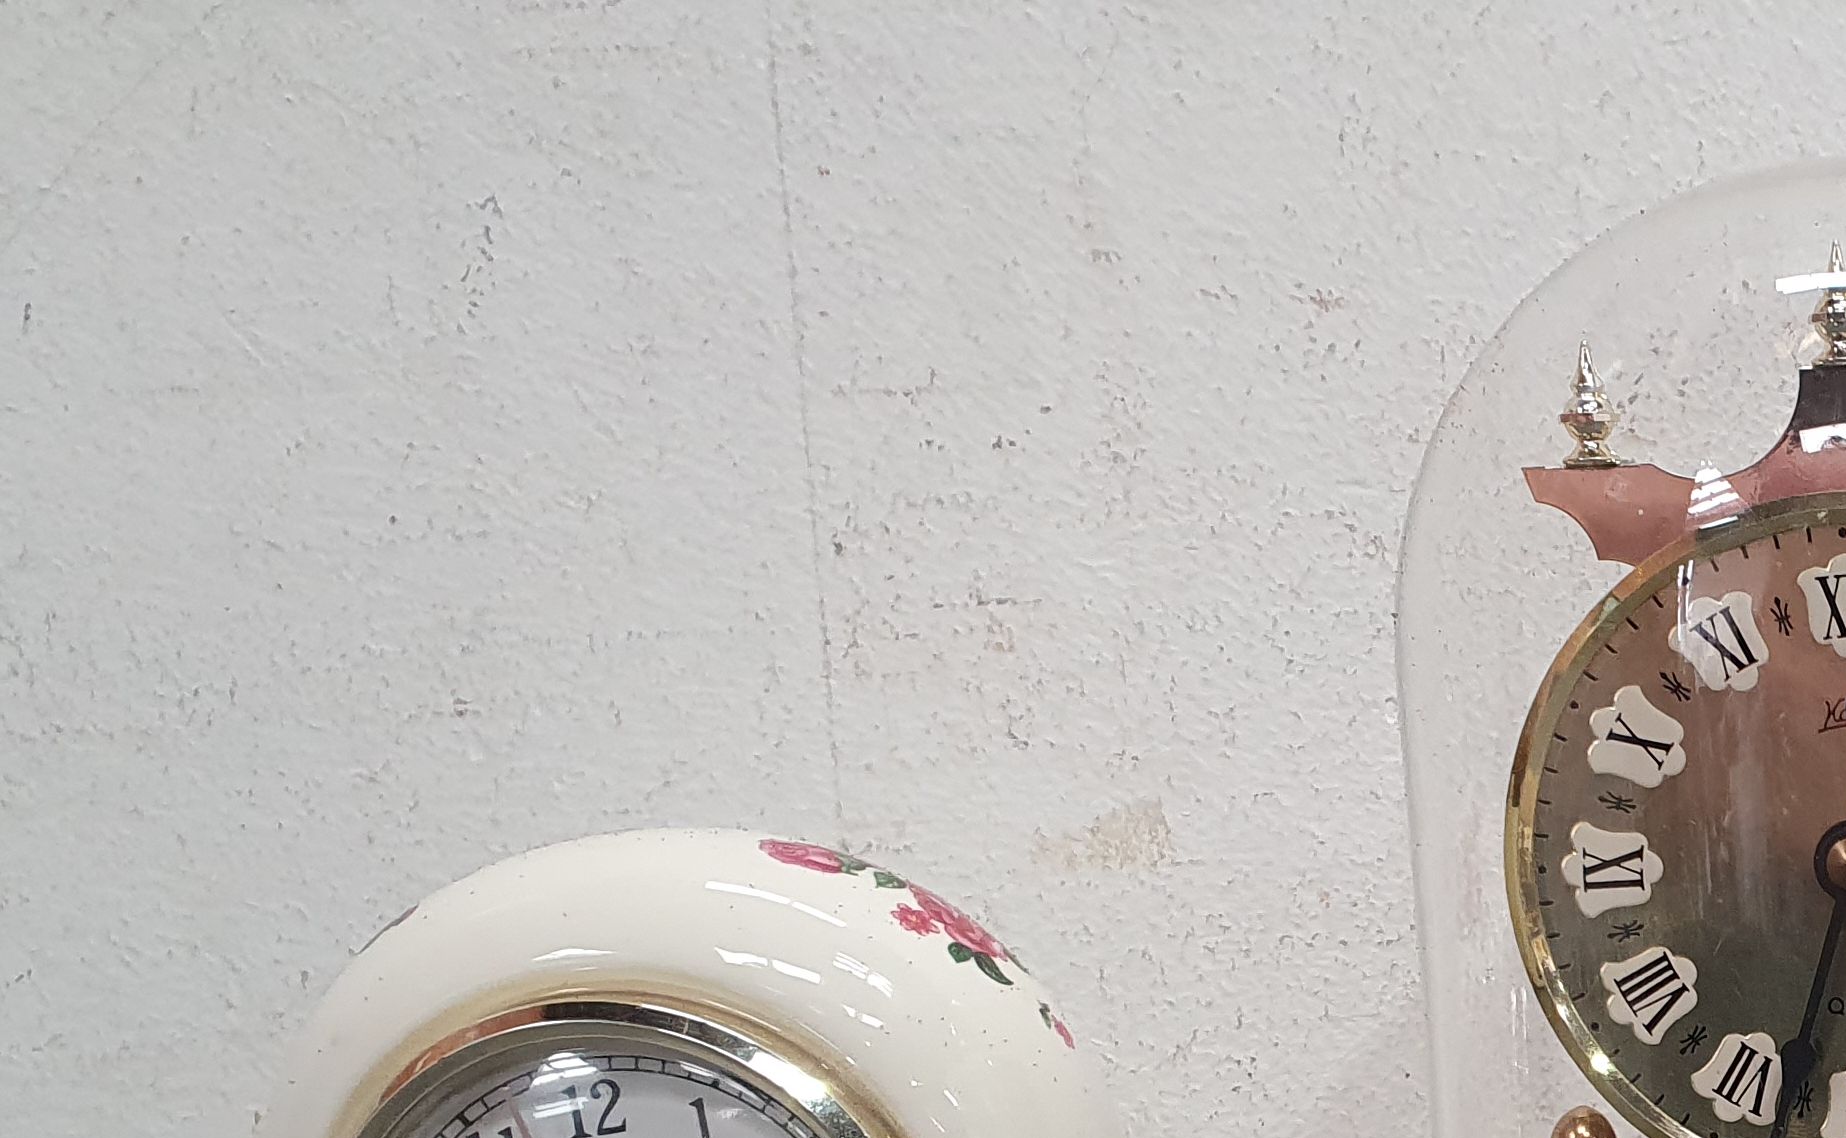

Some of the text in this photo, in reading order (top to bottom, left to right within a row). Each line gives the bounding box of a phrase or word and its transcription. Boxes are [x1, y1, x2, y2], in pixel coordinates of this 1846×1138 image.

[1690, 607, 1758, 681] XI
[1606, 713, 1675, 770] X
[1581, 845, 1645, 892] IX
[1614, 952, 1690, 1036] VIII
[563, 1079, 626, 1138] 12
[1711, 1042, 1770, 1118] VII
